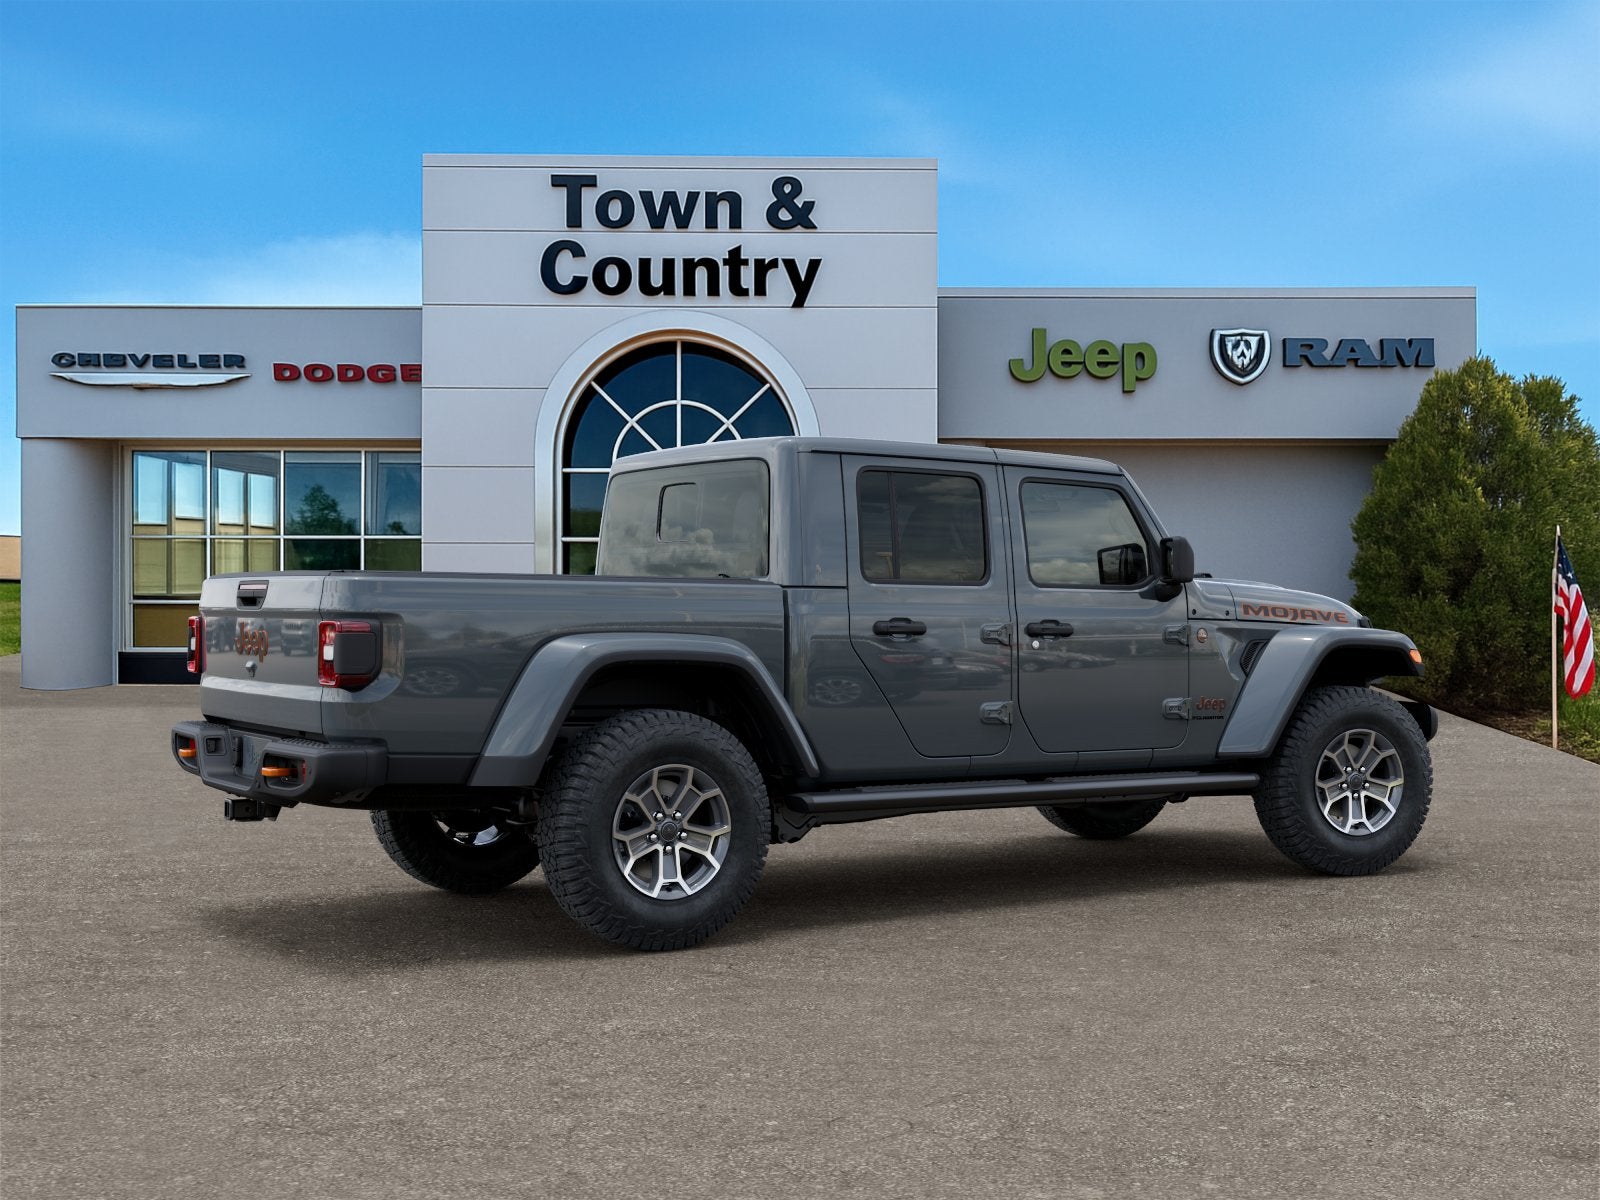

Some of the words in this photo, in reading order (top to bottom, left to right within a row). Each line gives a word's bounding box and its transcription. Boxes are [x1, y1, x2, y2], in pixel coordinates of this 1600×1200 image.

[550, 174, 742, 229] Town
[765, 176, 818, 230] &
[540, 239, 822, 308] Country
[1009, 328, 1157, 392] Jeep
[1282, 337, 1435, 368] RAM
[273, 363, 422, 383] DODGE
[1241, 602, 1349, 624] MOJAVE
[234, 621, 269, 664] Jeep
[1196, 696, 1225, 714] Jeep
